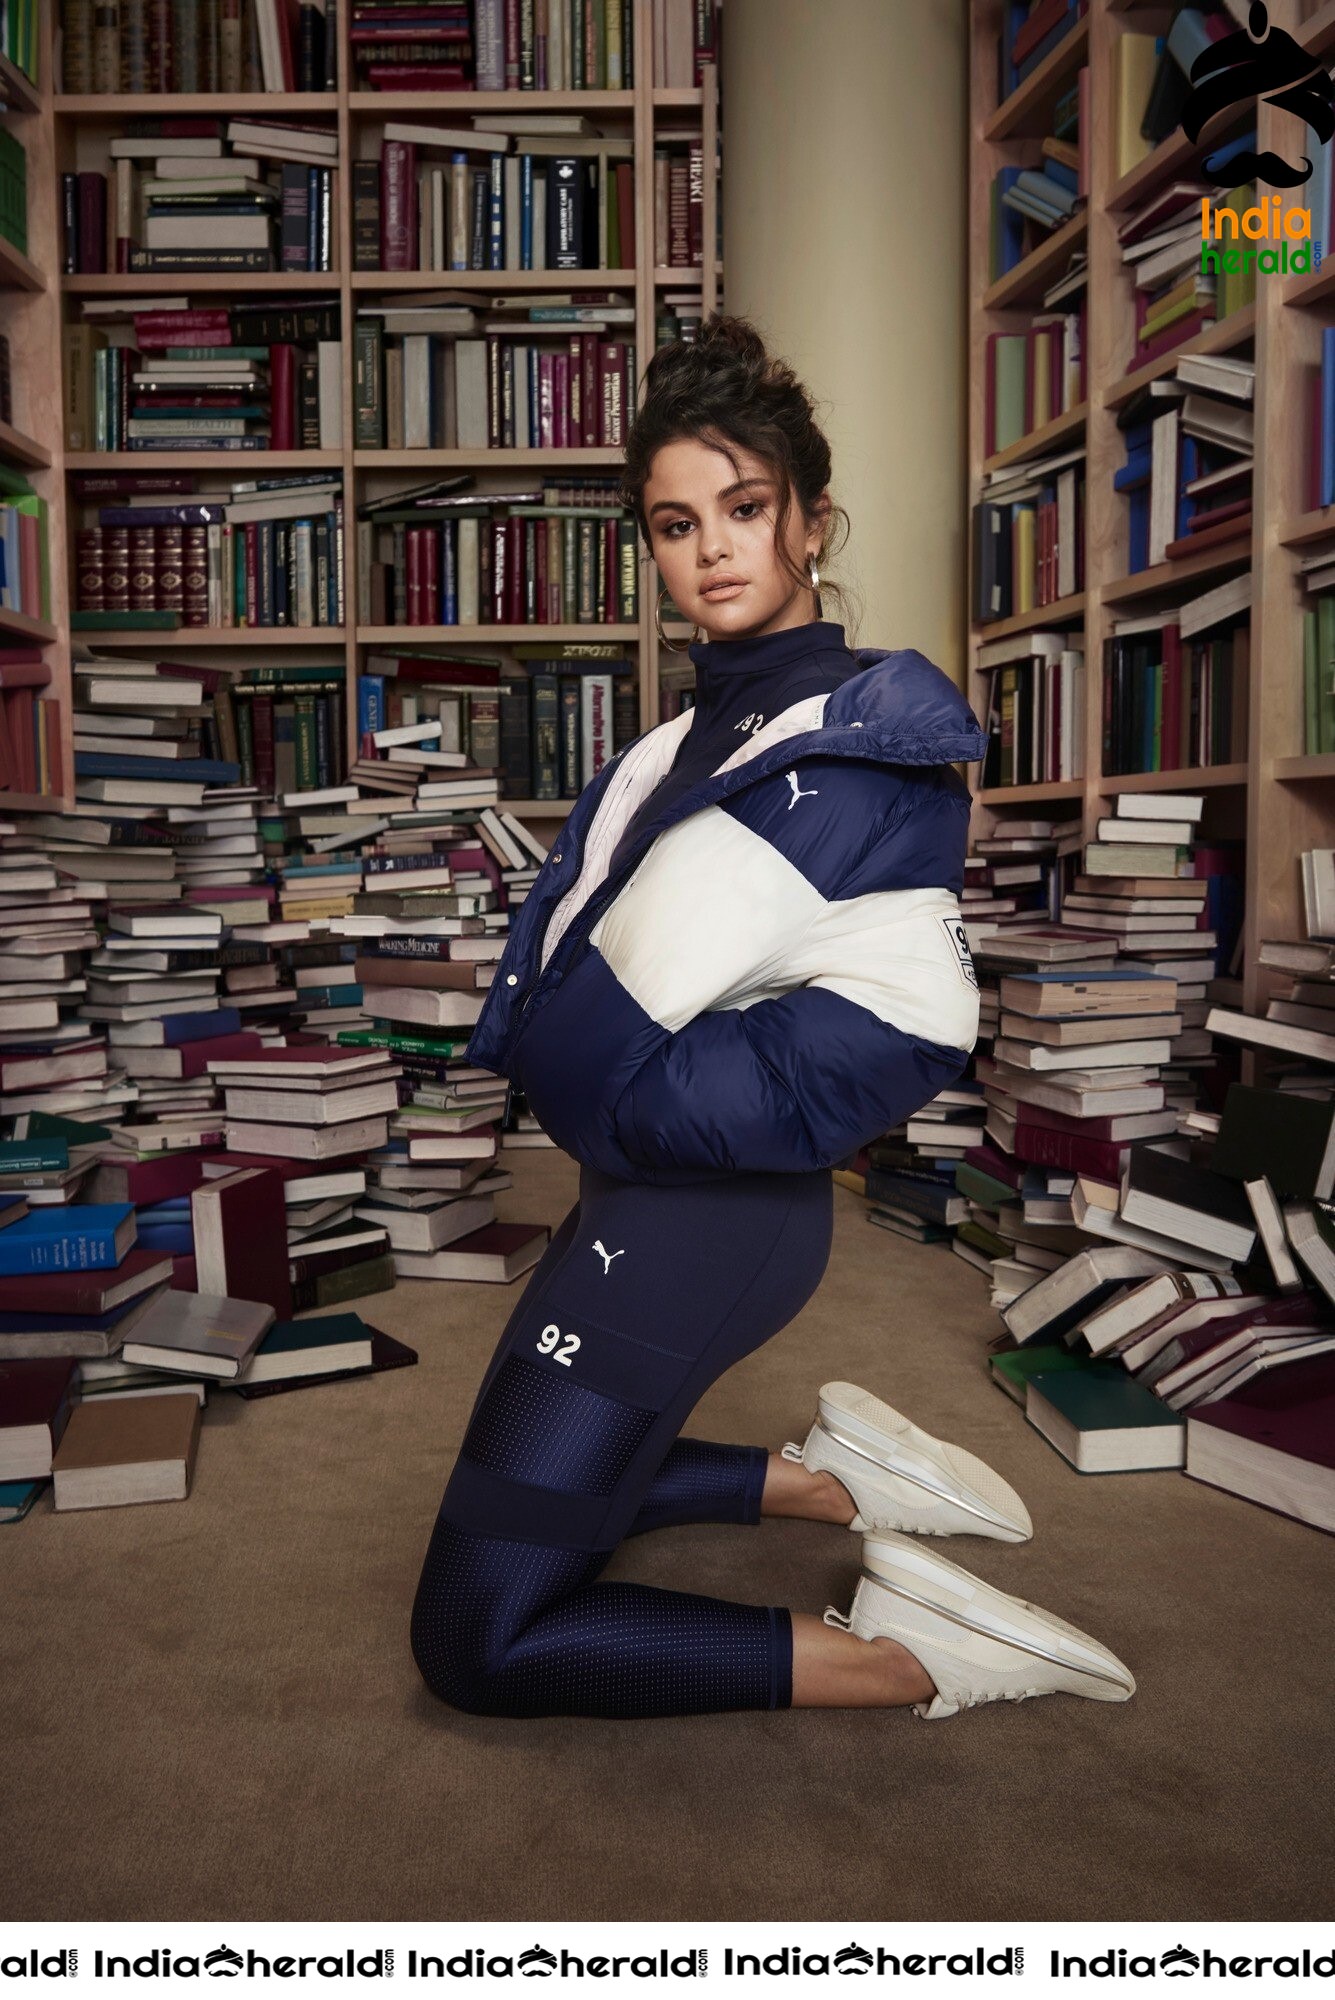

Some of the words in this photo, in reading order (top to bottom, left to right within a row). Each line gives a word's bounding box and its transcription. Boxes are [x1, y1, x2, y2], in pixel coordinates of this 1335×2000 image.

[611, 372, 622, 416] Prevention
[611, 417, 621, 446] Cancer
[592, 684, 605, 738] Alternative
[536, 1324, 581, 1367] 92
